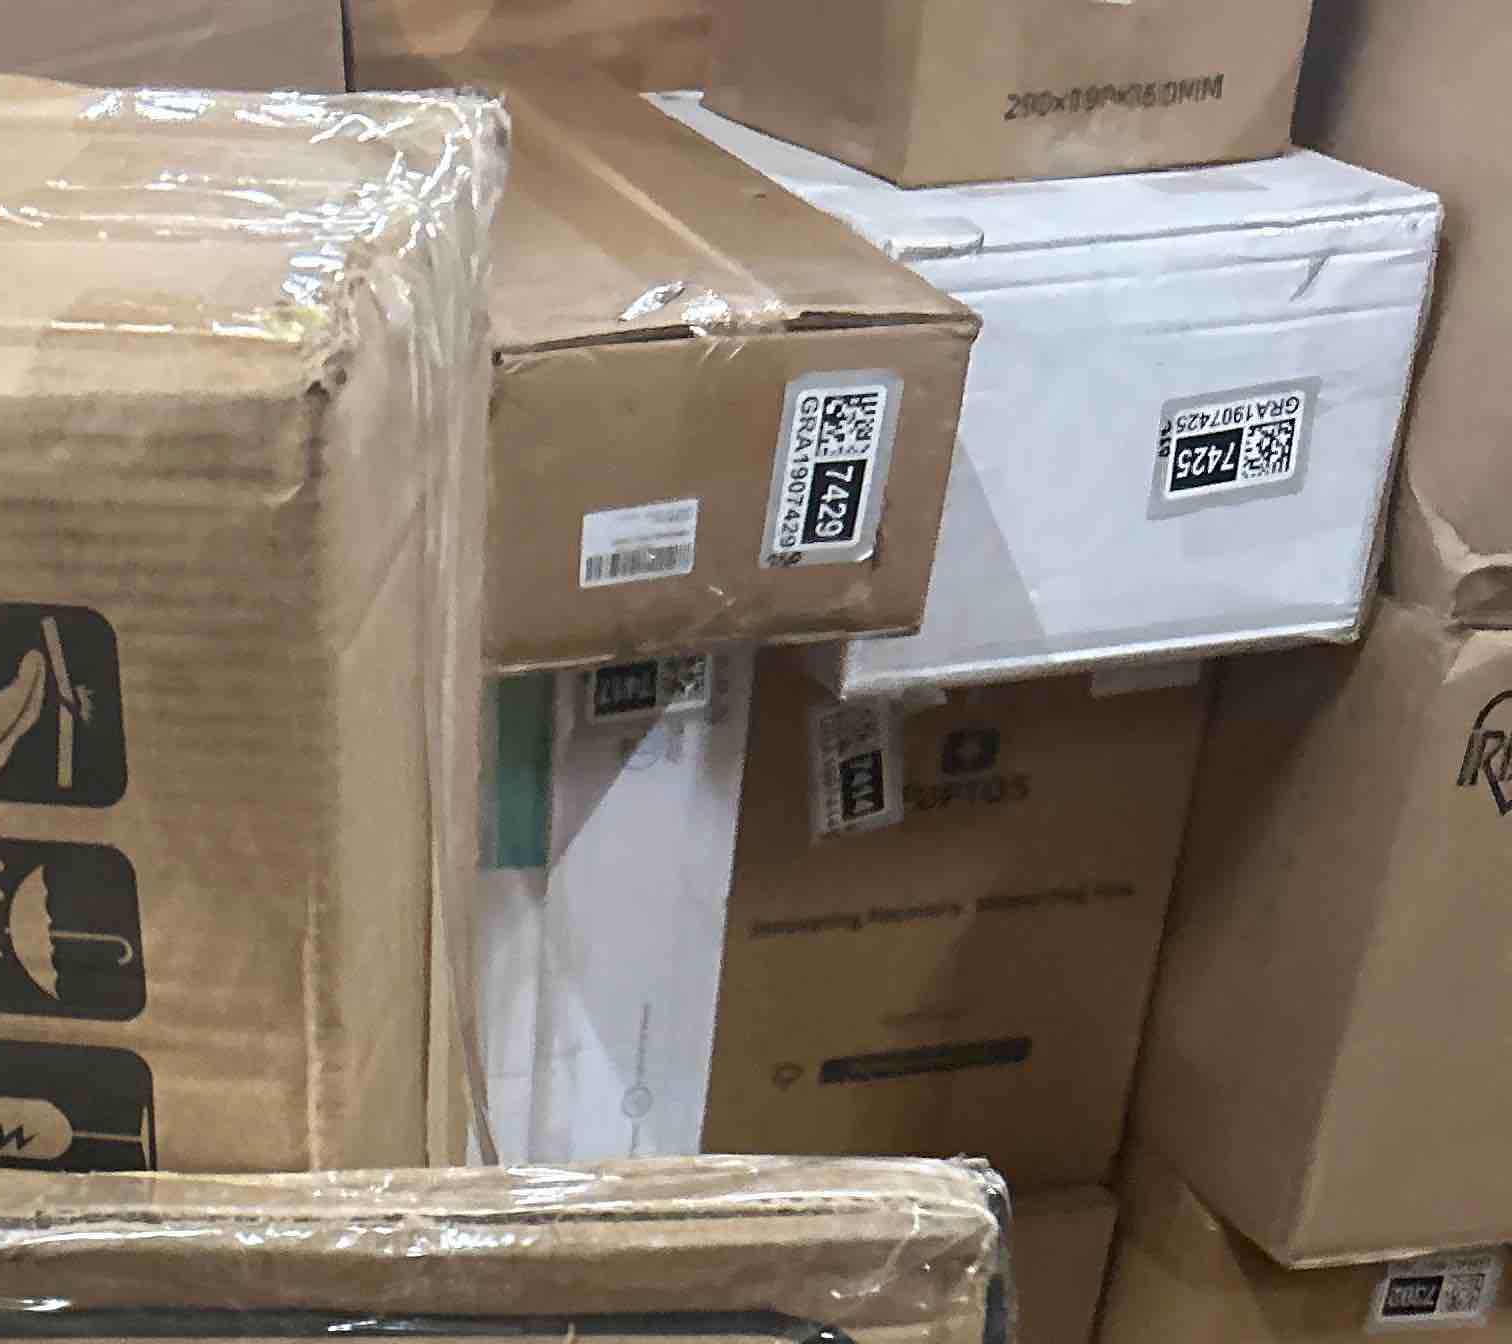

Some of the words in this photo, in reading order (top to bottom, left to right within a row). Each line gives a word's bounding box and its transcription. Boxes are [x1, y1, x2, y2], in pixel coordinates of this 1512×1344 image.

[1174, 395, 1301, 433] GRA1907425
[778, 395, 820, 550] GRA1907429
[1176, 432, 1236, 480] 7425
[815, 466, 857, 539] 7429
